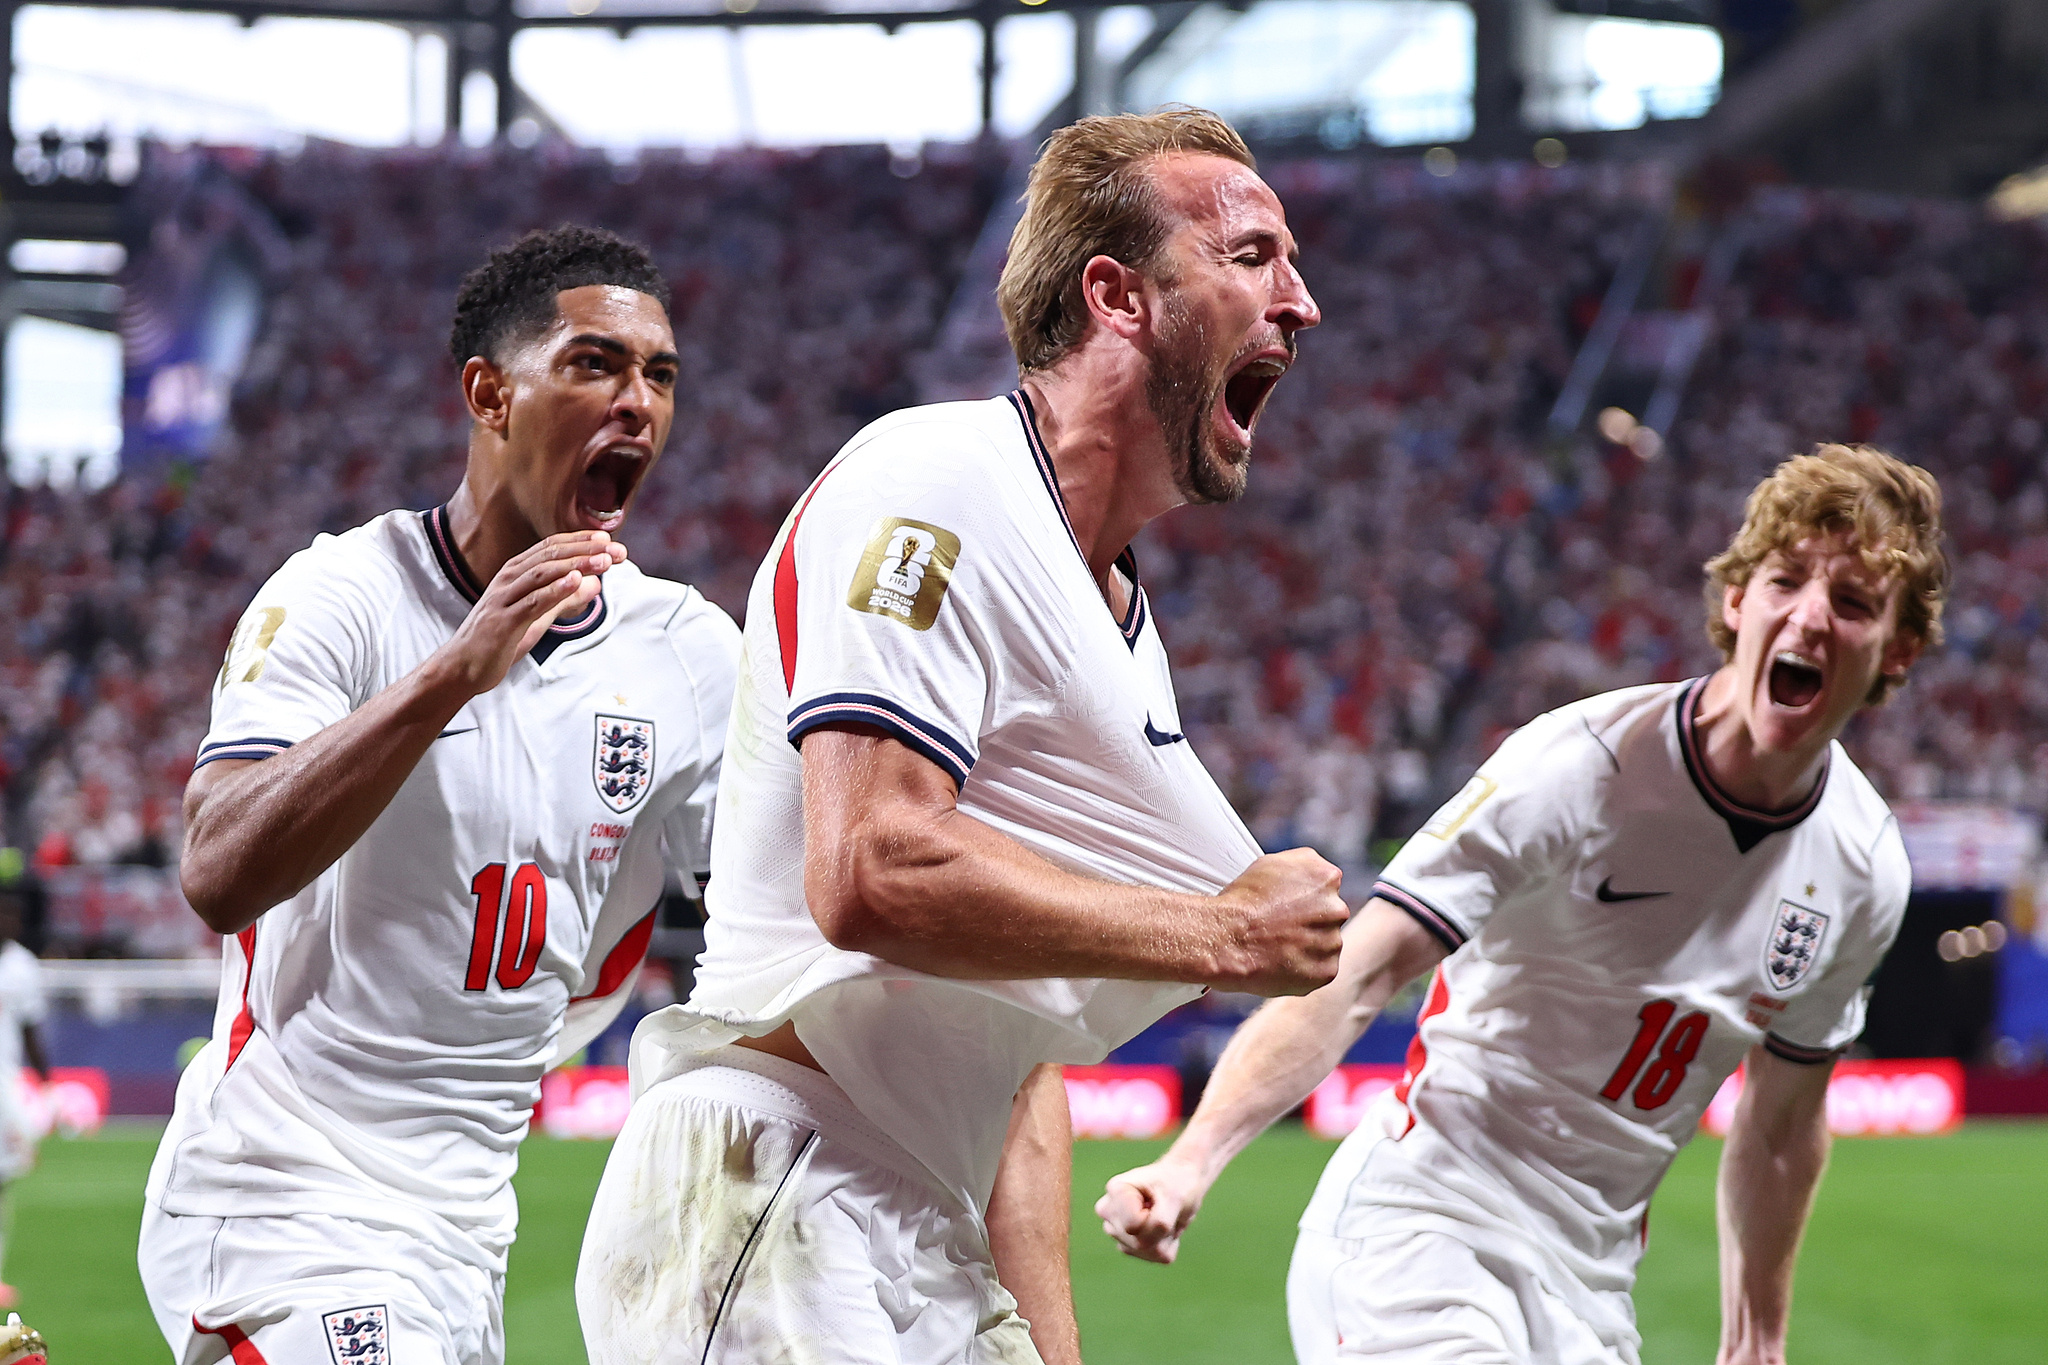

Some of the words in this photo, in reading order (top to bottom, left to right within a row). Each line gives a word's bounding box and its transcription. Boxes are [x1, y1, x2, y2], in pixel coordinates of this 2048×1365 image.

[889, 576, 907, 588] FIFA
[868, 595, 912, 617] 2026
[872, 588, 900, 601] WORLD
[899, 596, 915, 606] CUP
[589, 822, 625, 838] CONGO
[464, 862, 547, 991] 10
[1598, 998, 1711, 1110] 18
